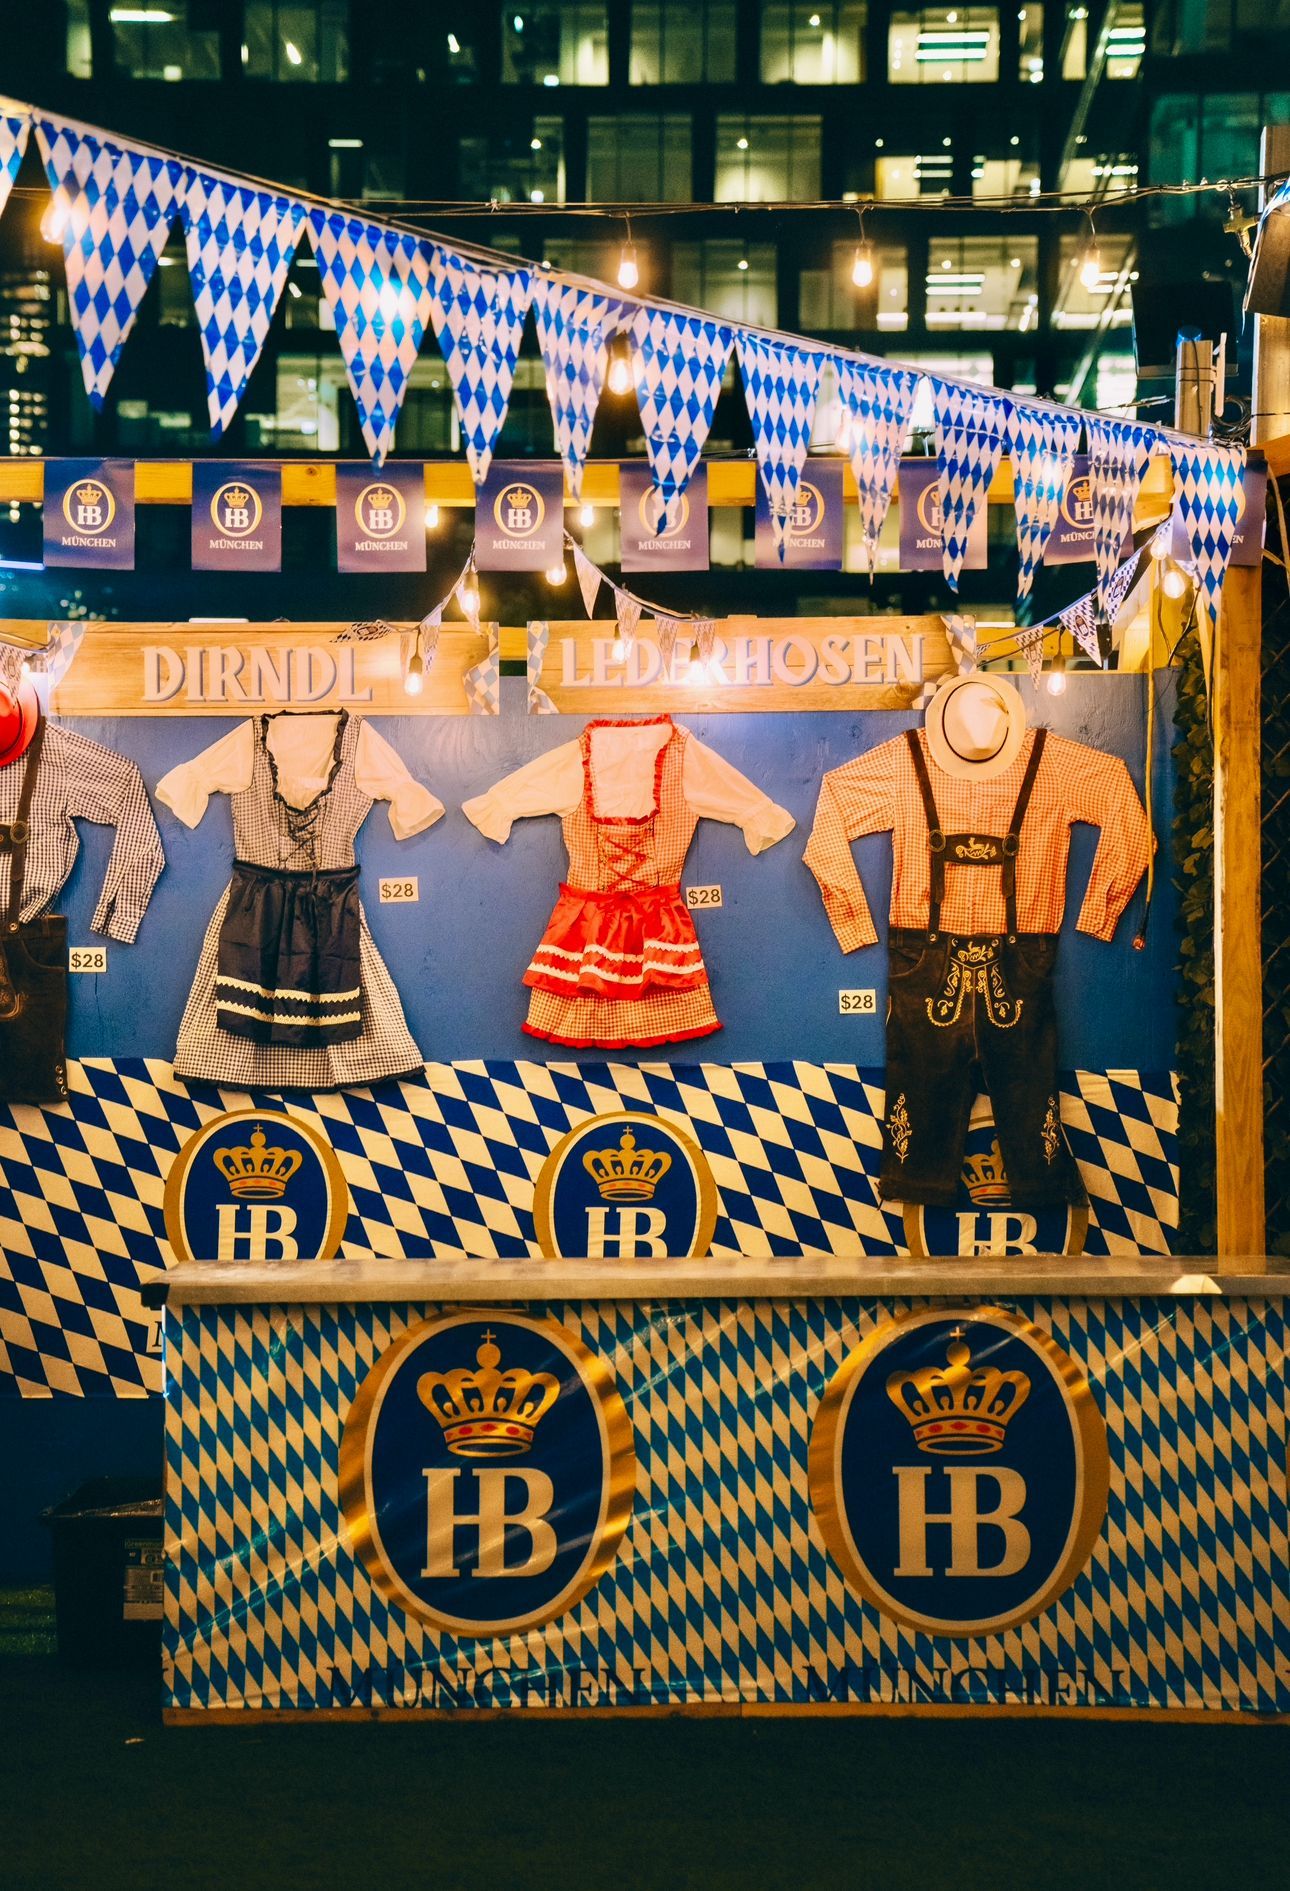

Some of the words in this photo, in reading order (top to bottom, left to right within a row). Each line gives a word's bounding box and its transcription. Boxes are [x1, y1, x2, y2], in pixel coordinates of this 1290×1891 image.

[77, 505, 102, 526] HB
[225, 508, 250, 528] HB
[369, 508, 393, 529] HB
[507, 508, 532, 529] HB
[61, 535, 117, 548] MÜNCHEN
[209, 538, 264, 550] MÜNCHEN
[355, 540, 408, 551] MÜNCHEN
[492, 539, 546, 550] MÜNCHEN
[638, 539, 691, 550] MÜNCHEN
[559, 634, 925, 688] LEDERHOSEN
[140, 646, 373, 702] DIRNDL
[381, 882, 414, 900] $28
[688, 888, 721, 907] $28
[71, 951, 104, 970] $28
[840, 993, 873, 1012] $28
[215, 1204, 299, 1261] HB
[585, 1206, 668, 1258] HB
[421, 1467, 557, 1578] HB
[892, 1466, 1031, 1577] HB
